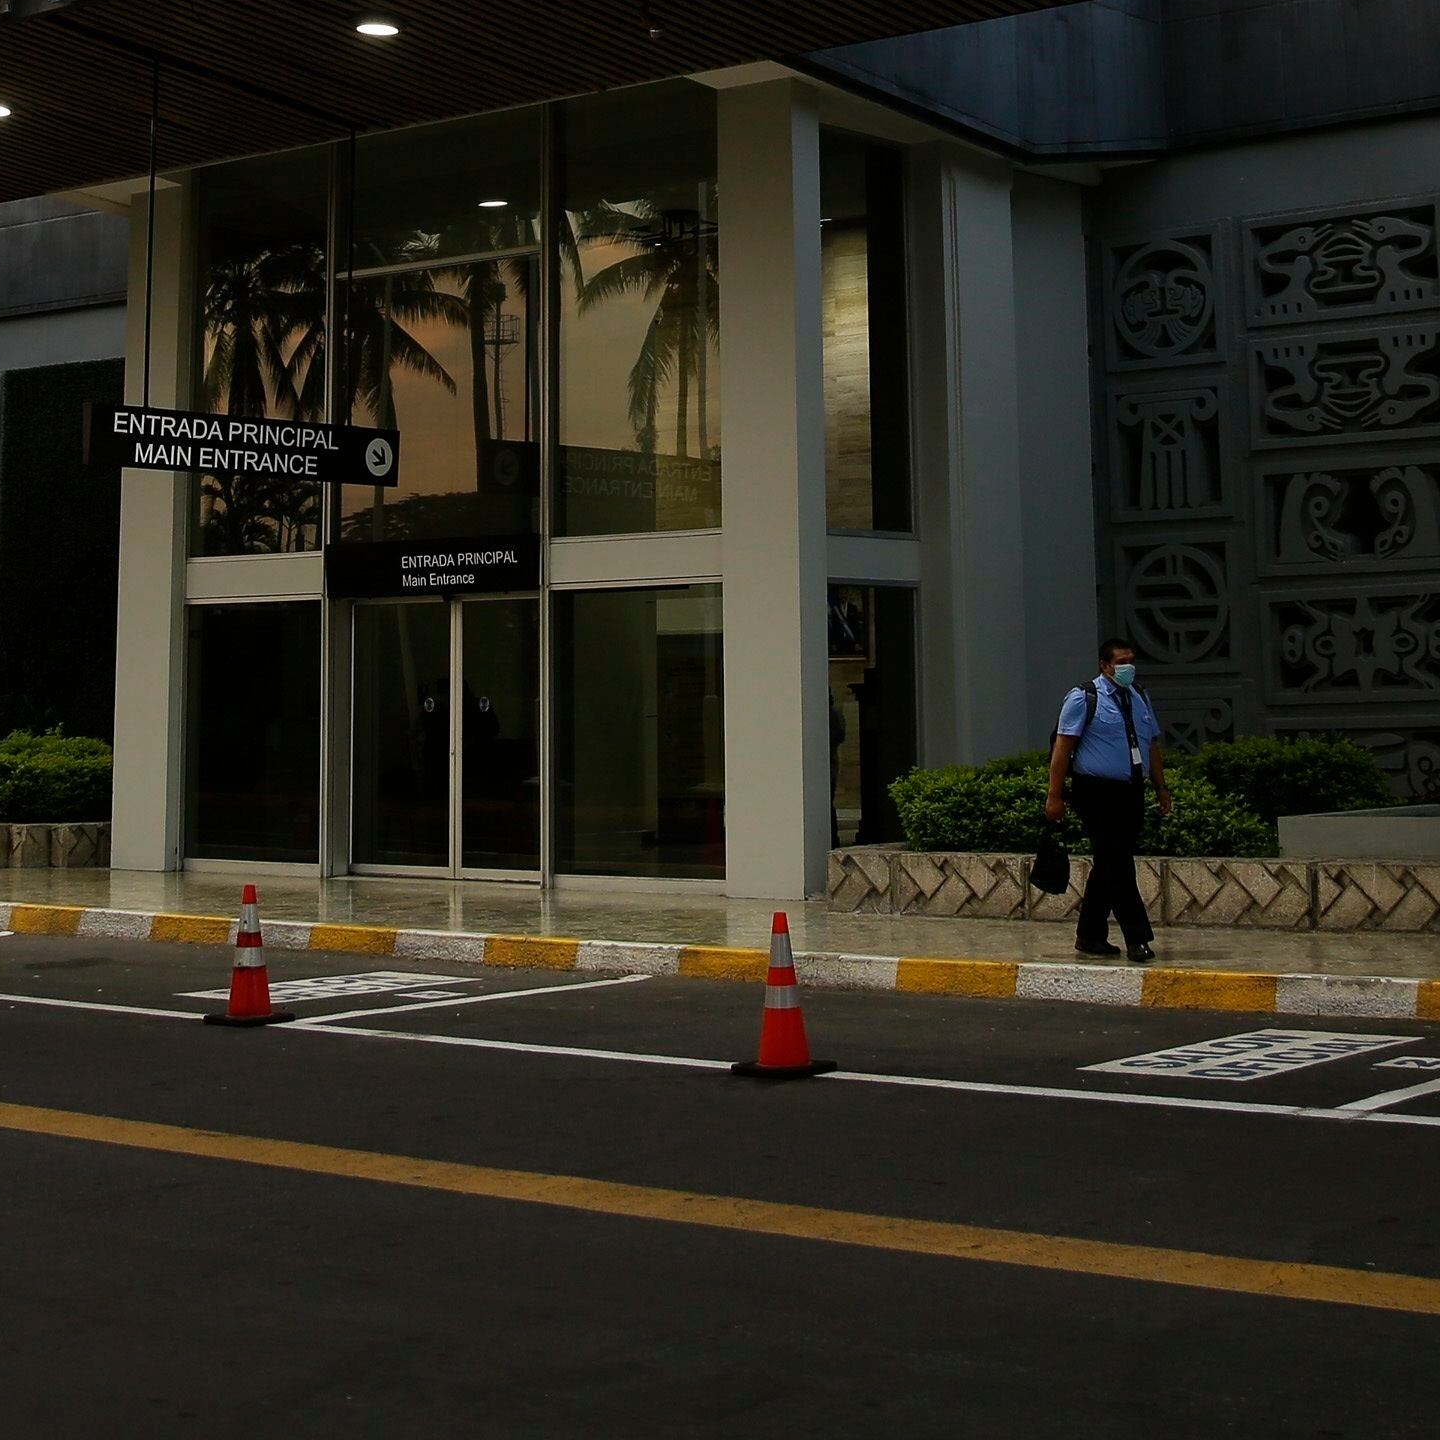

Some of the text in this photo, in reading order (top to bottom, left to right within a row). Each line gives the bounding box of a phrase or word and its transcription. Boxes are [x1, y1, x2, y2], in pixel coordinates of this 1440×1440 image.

[113, 411, 340, 450] ENTRADA PRINCIPAL
[134, 443, 318, 475] MAIN ENTRANCE
[401, 550, 519, 569] ENTRADA PRINCIPAL
[402, 572, 476, 587] Main Entrance
[1119, 1032, 1310, 1069] SALON
[1188, 1037, 1404, 1077] OFICIAL
